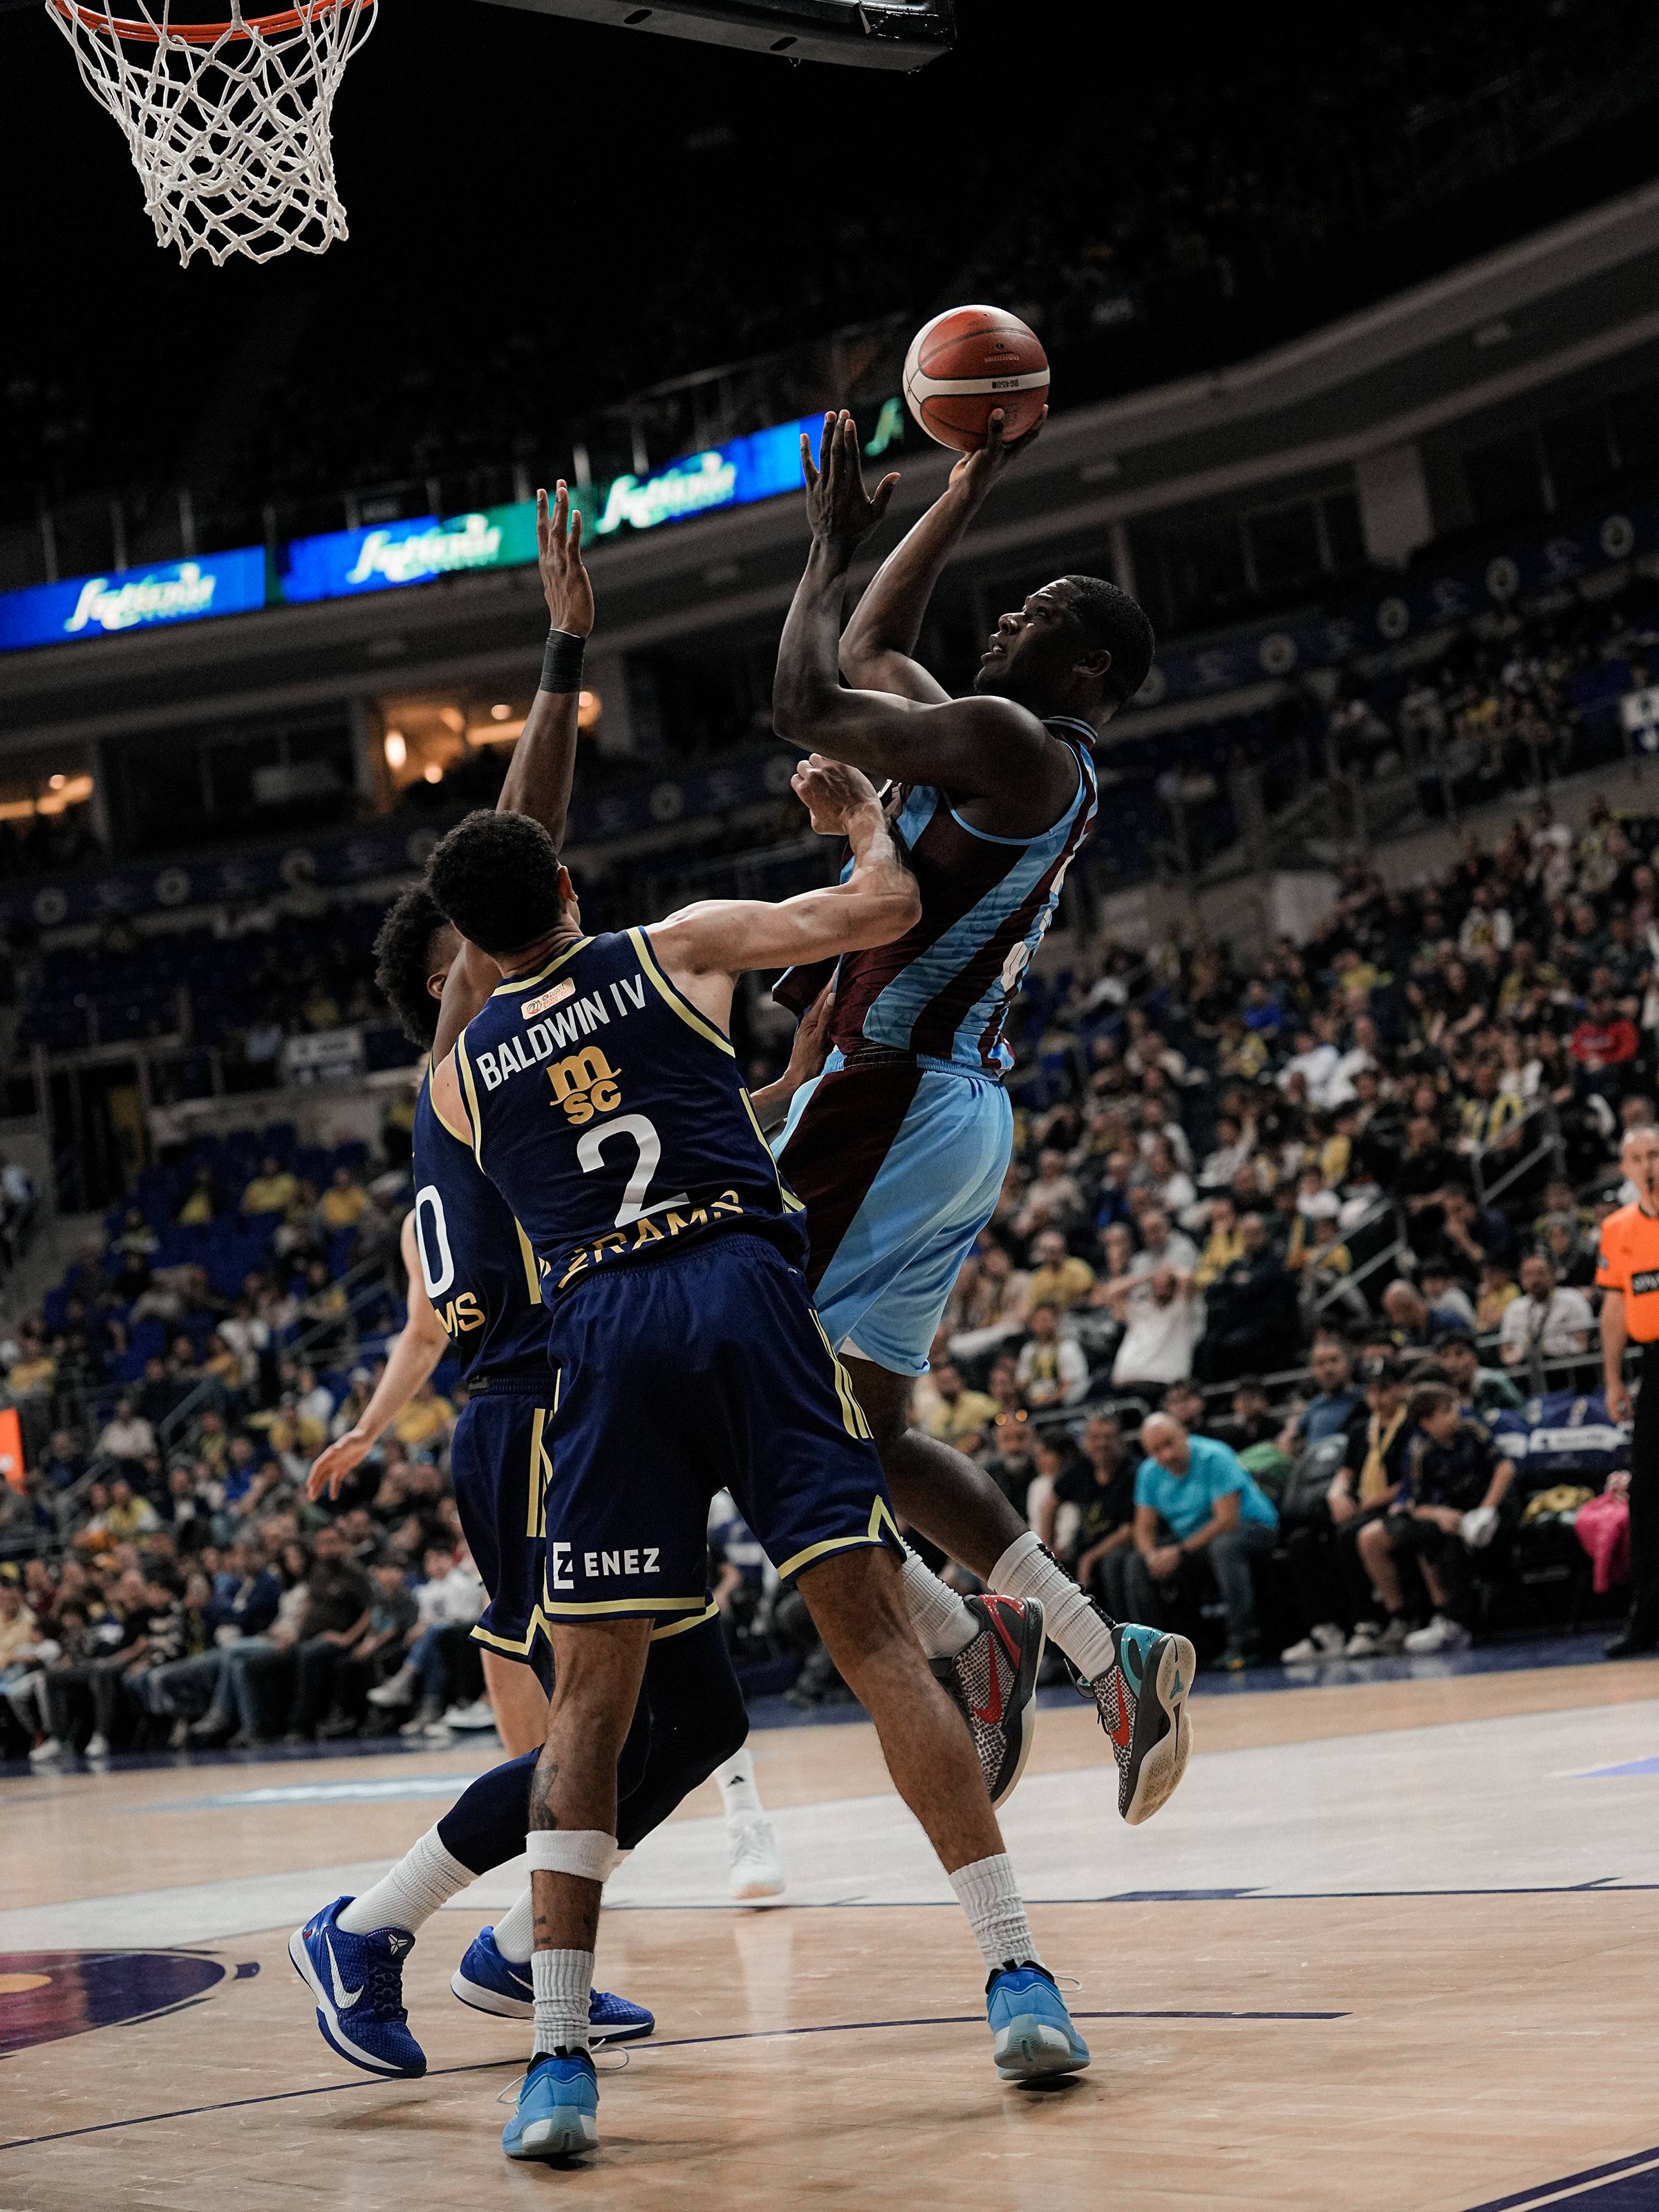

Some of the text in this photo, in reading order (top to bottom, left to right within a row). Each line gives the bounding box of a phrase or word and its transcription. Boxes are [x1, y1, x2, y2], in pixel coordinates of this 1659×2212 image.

[476, 973, 646, 1091] BALDWIN IV
[577, 1114, 691, 1228] 2
[415, 1185, 455, 1299] 0
[584, 1548, 660, 1577] ENEZ
